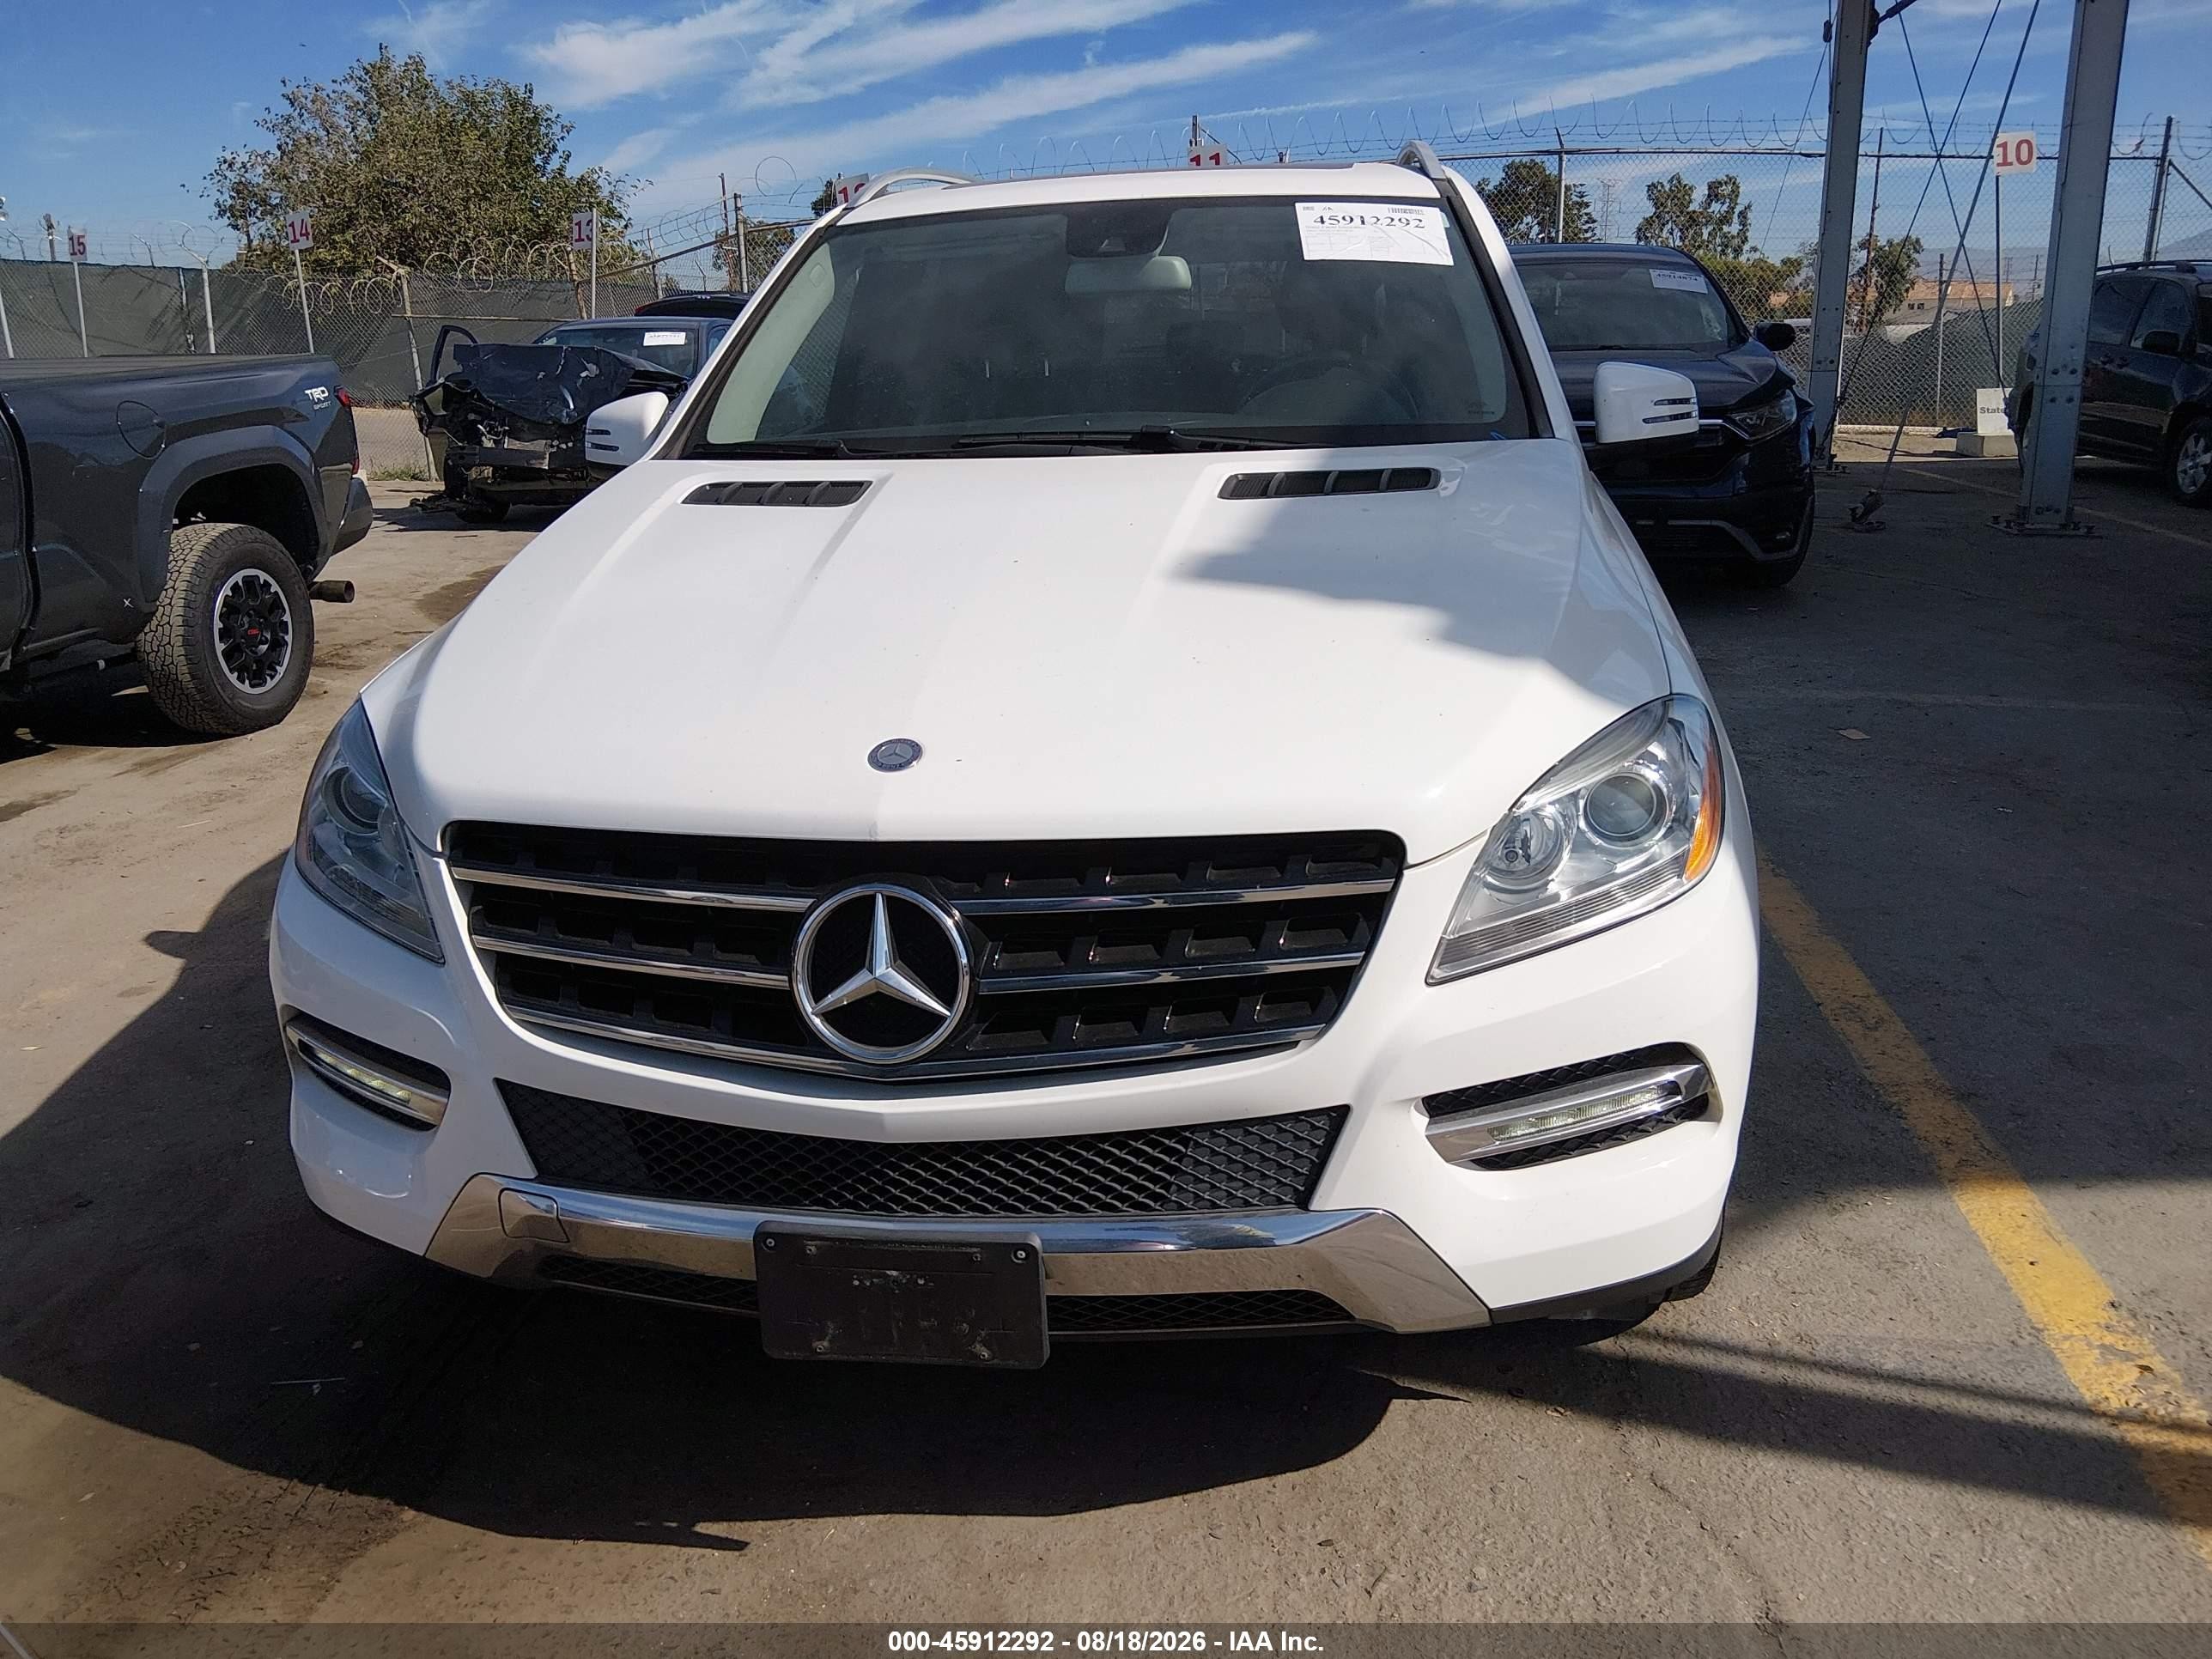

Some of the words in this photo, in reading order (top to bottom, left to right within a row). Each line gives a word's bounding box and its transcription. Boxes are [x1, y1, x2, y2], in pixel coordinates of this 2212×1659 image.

[1996, 139, 2033, 167] 10
[289, 219, 310, 244] 14
[574, 219, 592, 242] 13
[1314, 215, 1425, 228] 45912292
[69, 234, 87, 256] 15
[304, 386, 329, 402] TRD
